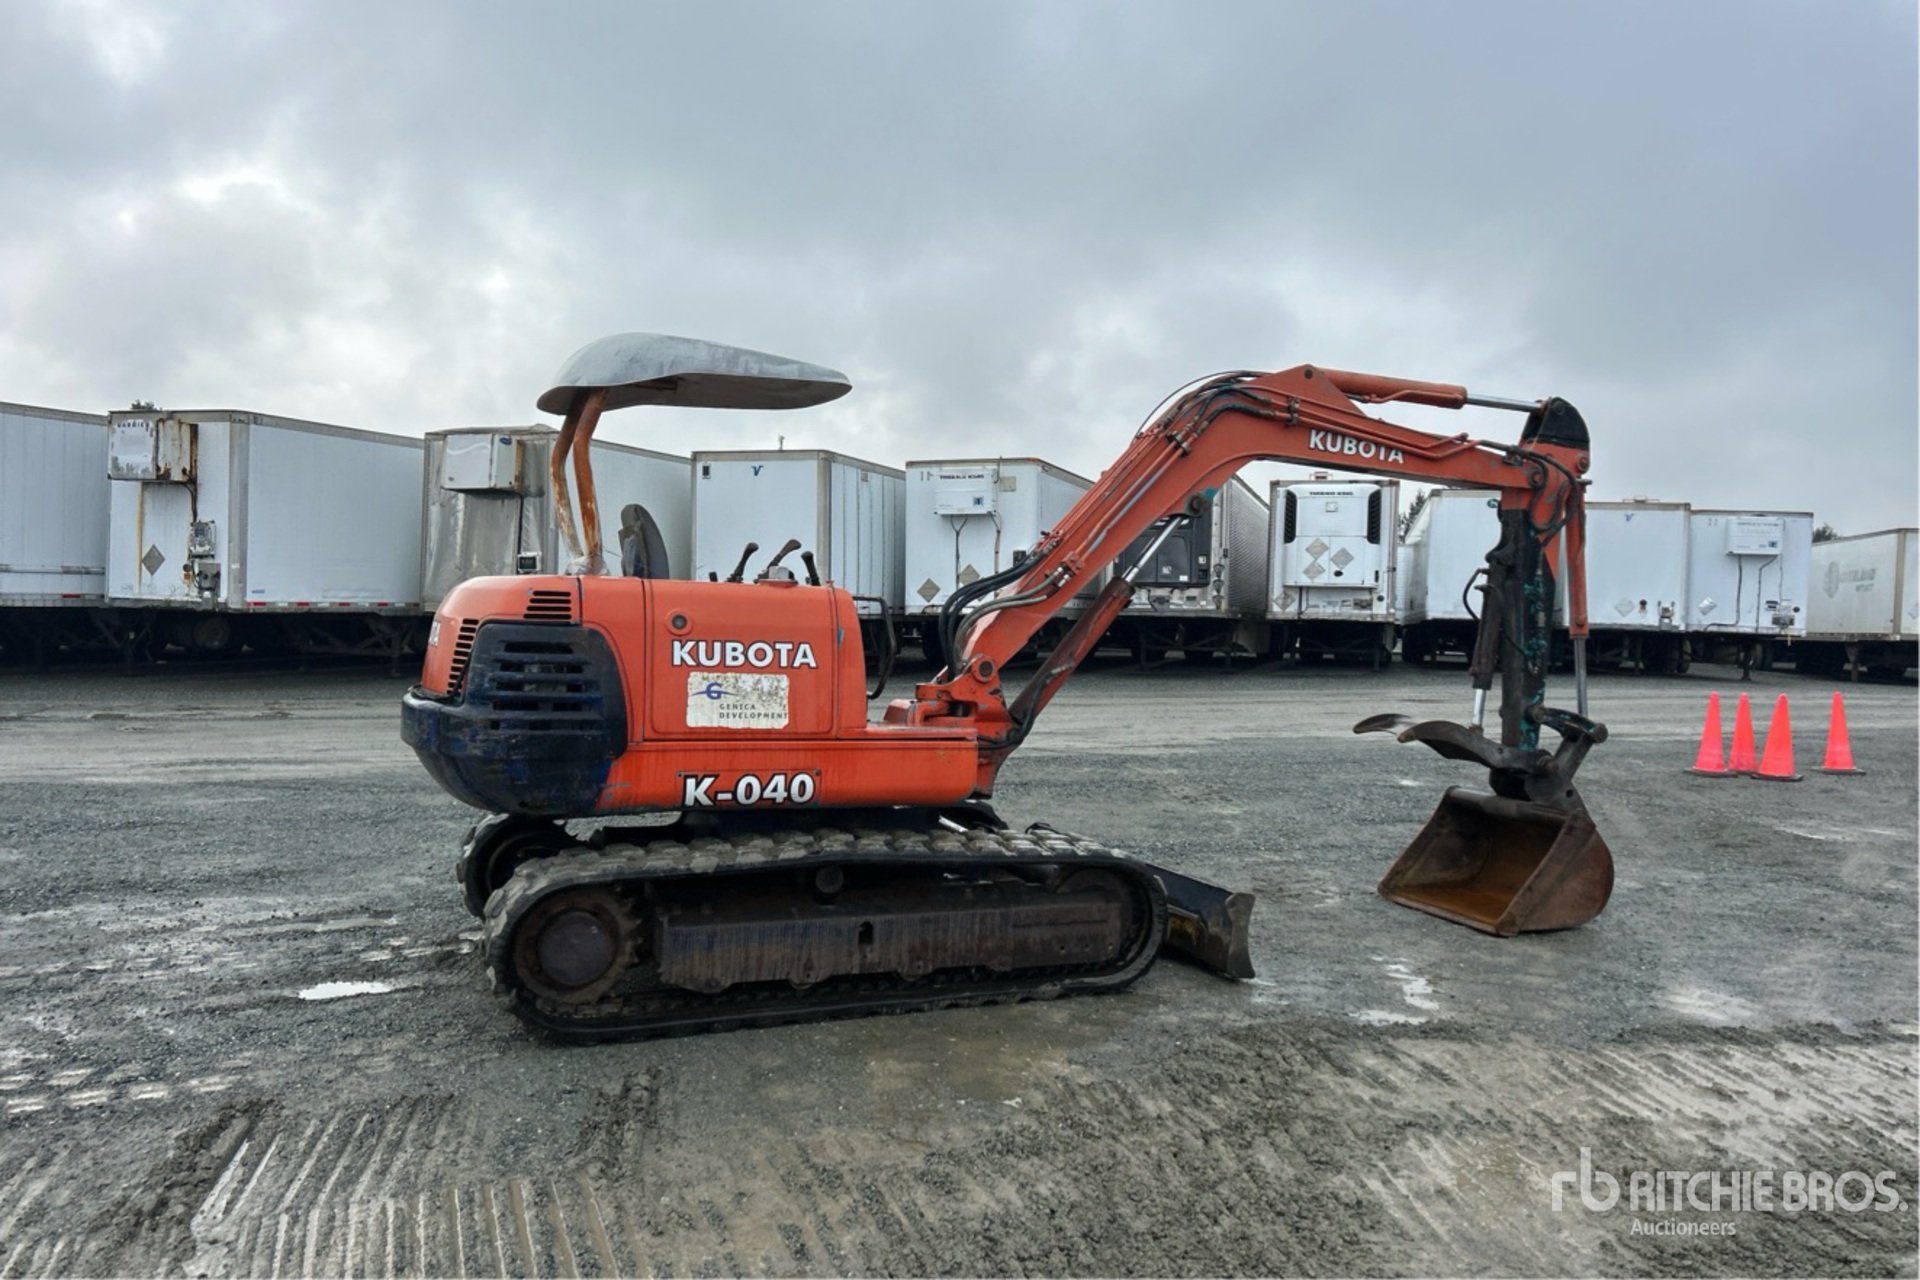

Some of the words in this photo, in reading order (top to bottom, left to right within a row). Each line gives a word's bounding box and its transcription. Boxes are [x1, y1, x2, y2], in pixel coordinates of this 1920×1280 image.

[1308, 428, 1405, 465] KUBOTA
[671, 639, 818, 669] KUBOTA
[683, 771, 816, 807] K-040
